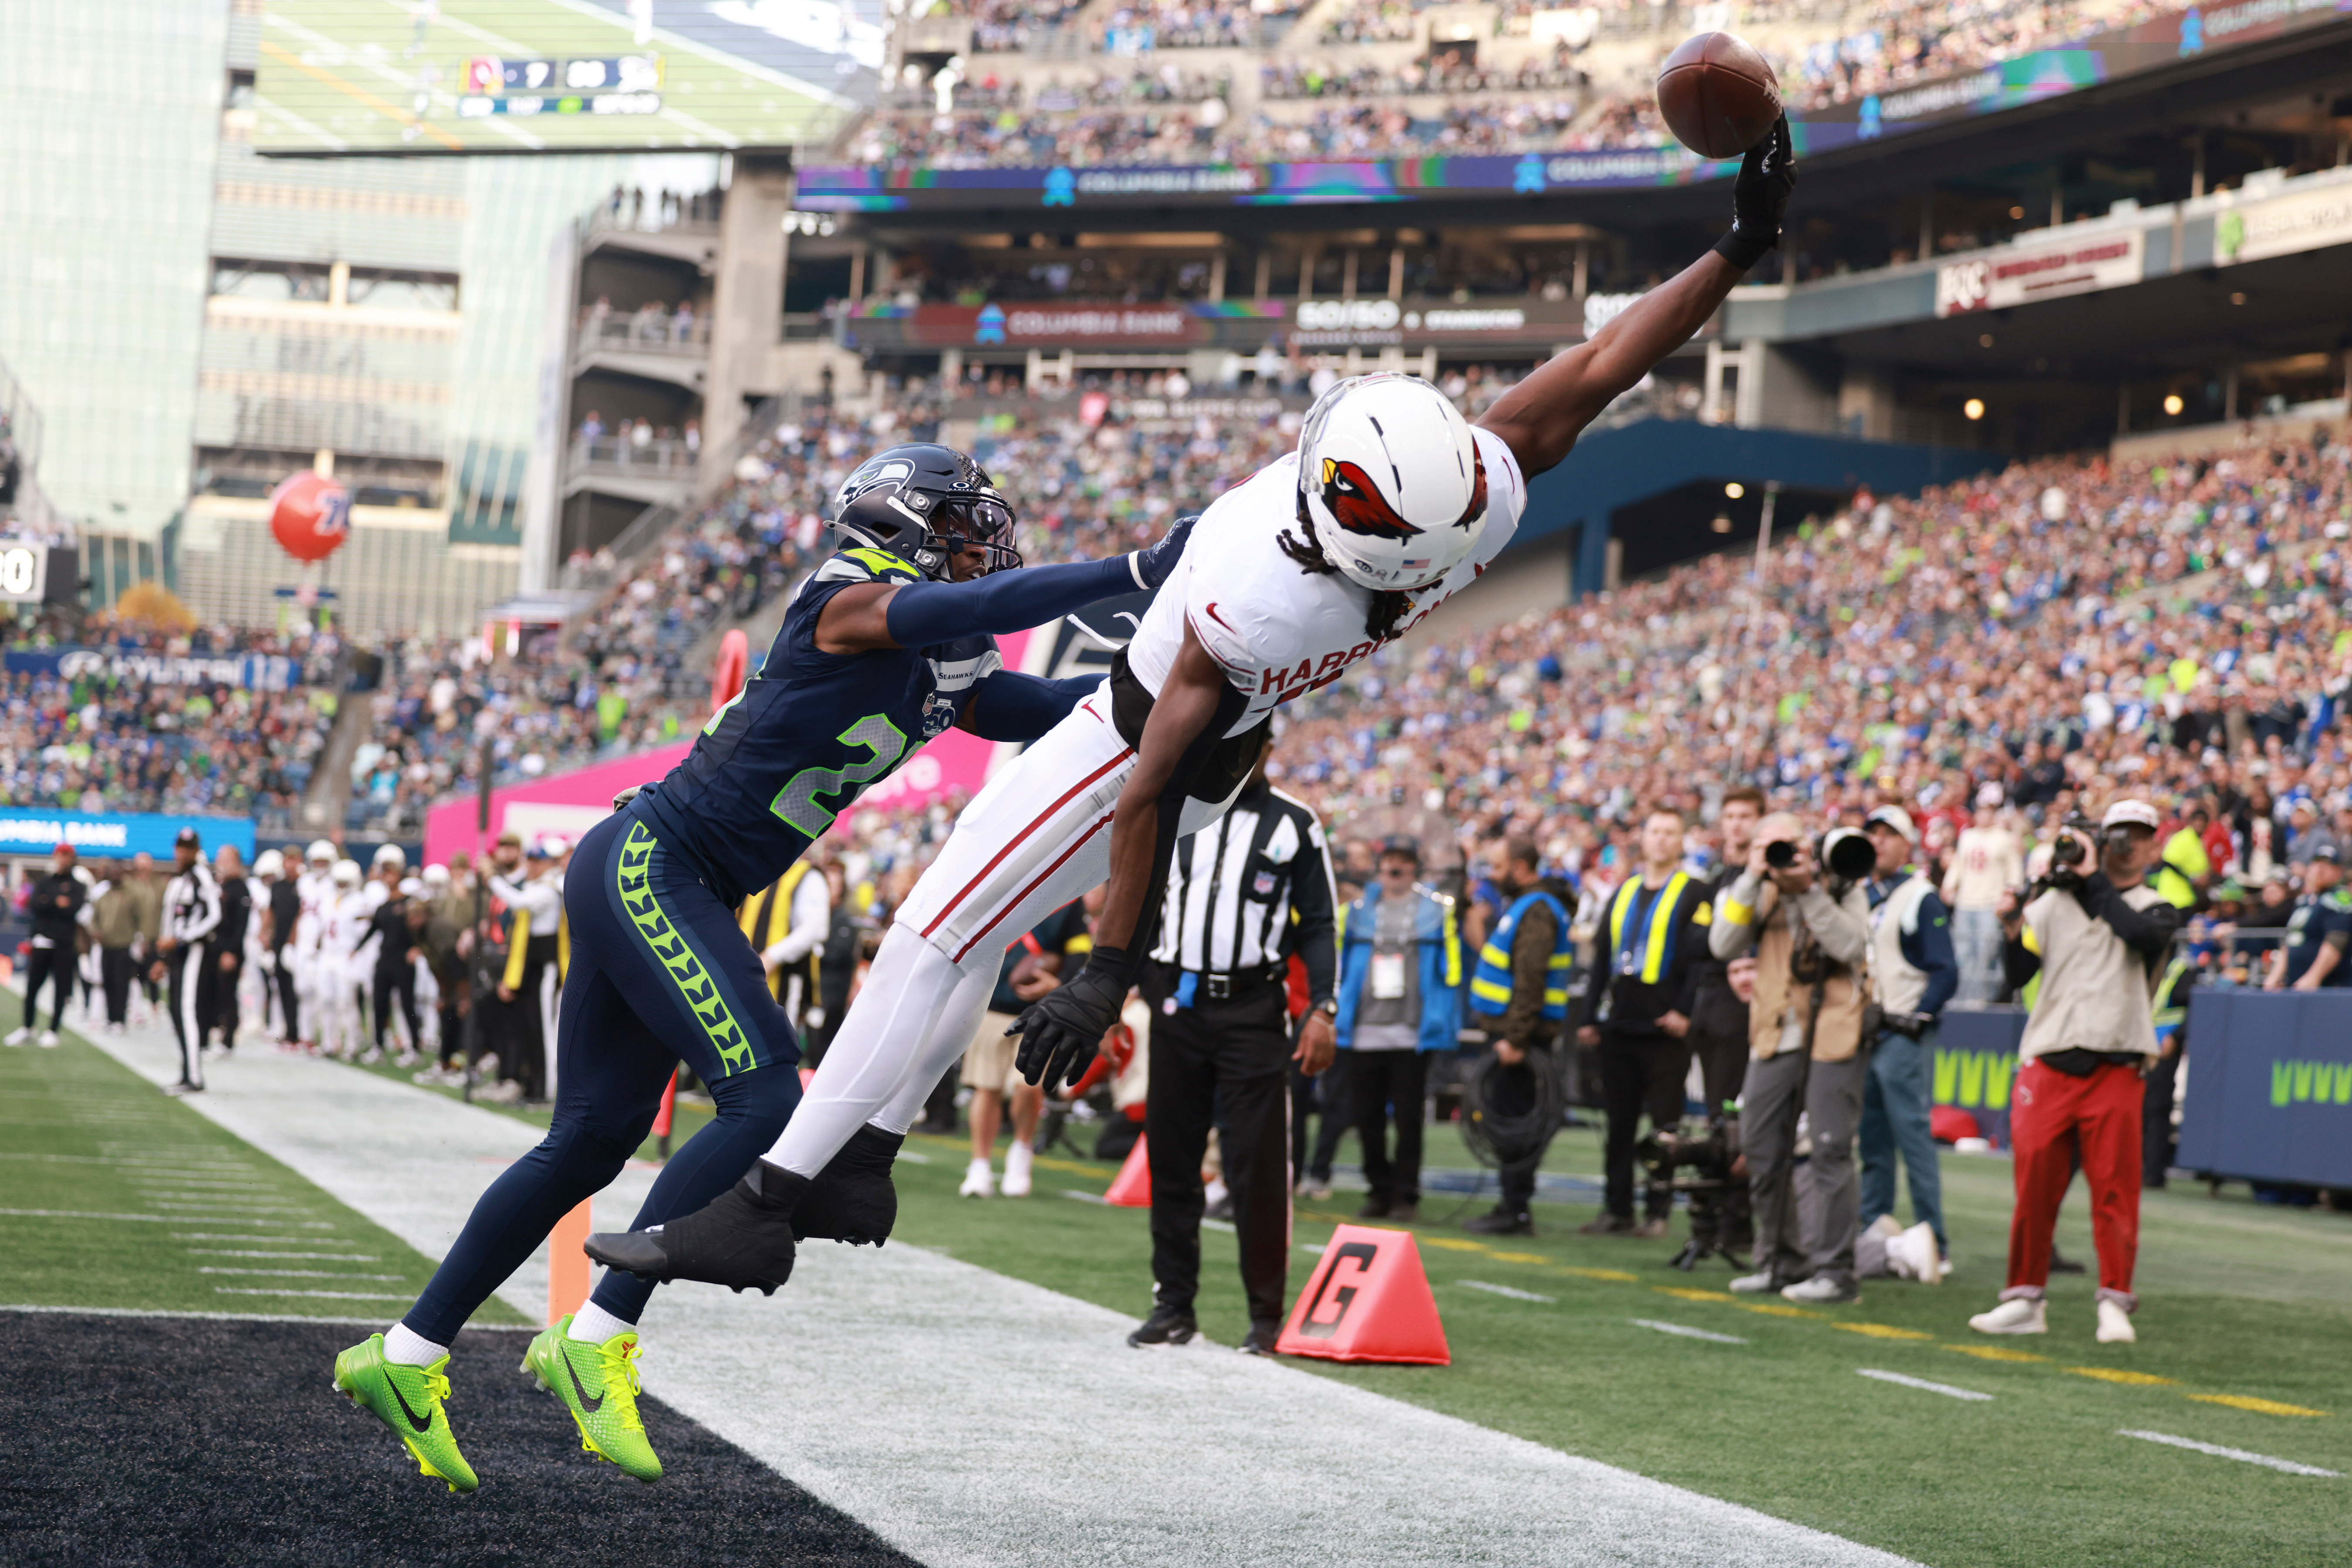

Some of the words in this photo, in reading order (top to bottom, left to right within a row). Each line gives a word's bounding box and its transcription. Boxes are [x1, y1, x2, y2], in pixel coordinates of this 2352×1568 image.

[1008, 311, 1119, 335] COLUMBIA
[0, 547, 34, 595] 0
[938, 671, 973, 680] SEAHAWKS
[923, 705, 956, 734] 50
[770, 713, 927, 839] 2
[1299, 1242, 1378, 1339] G
